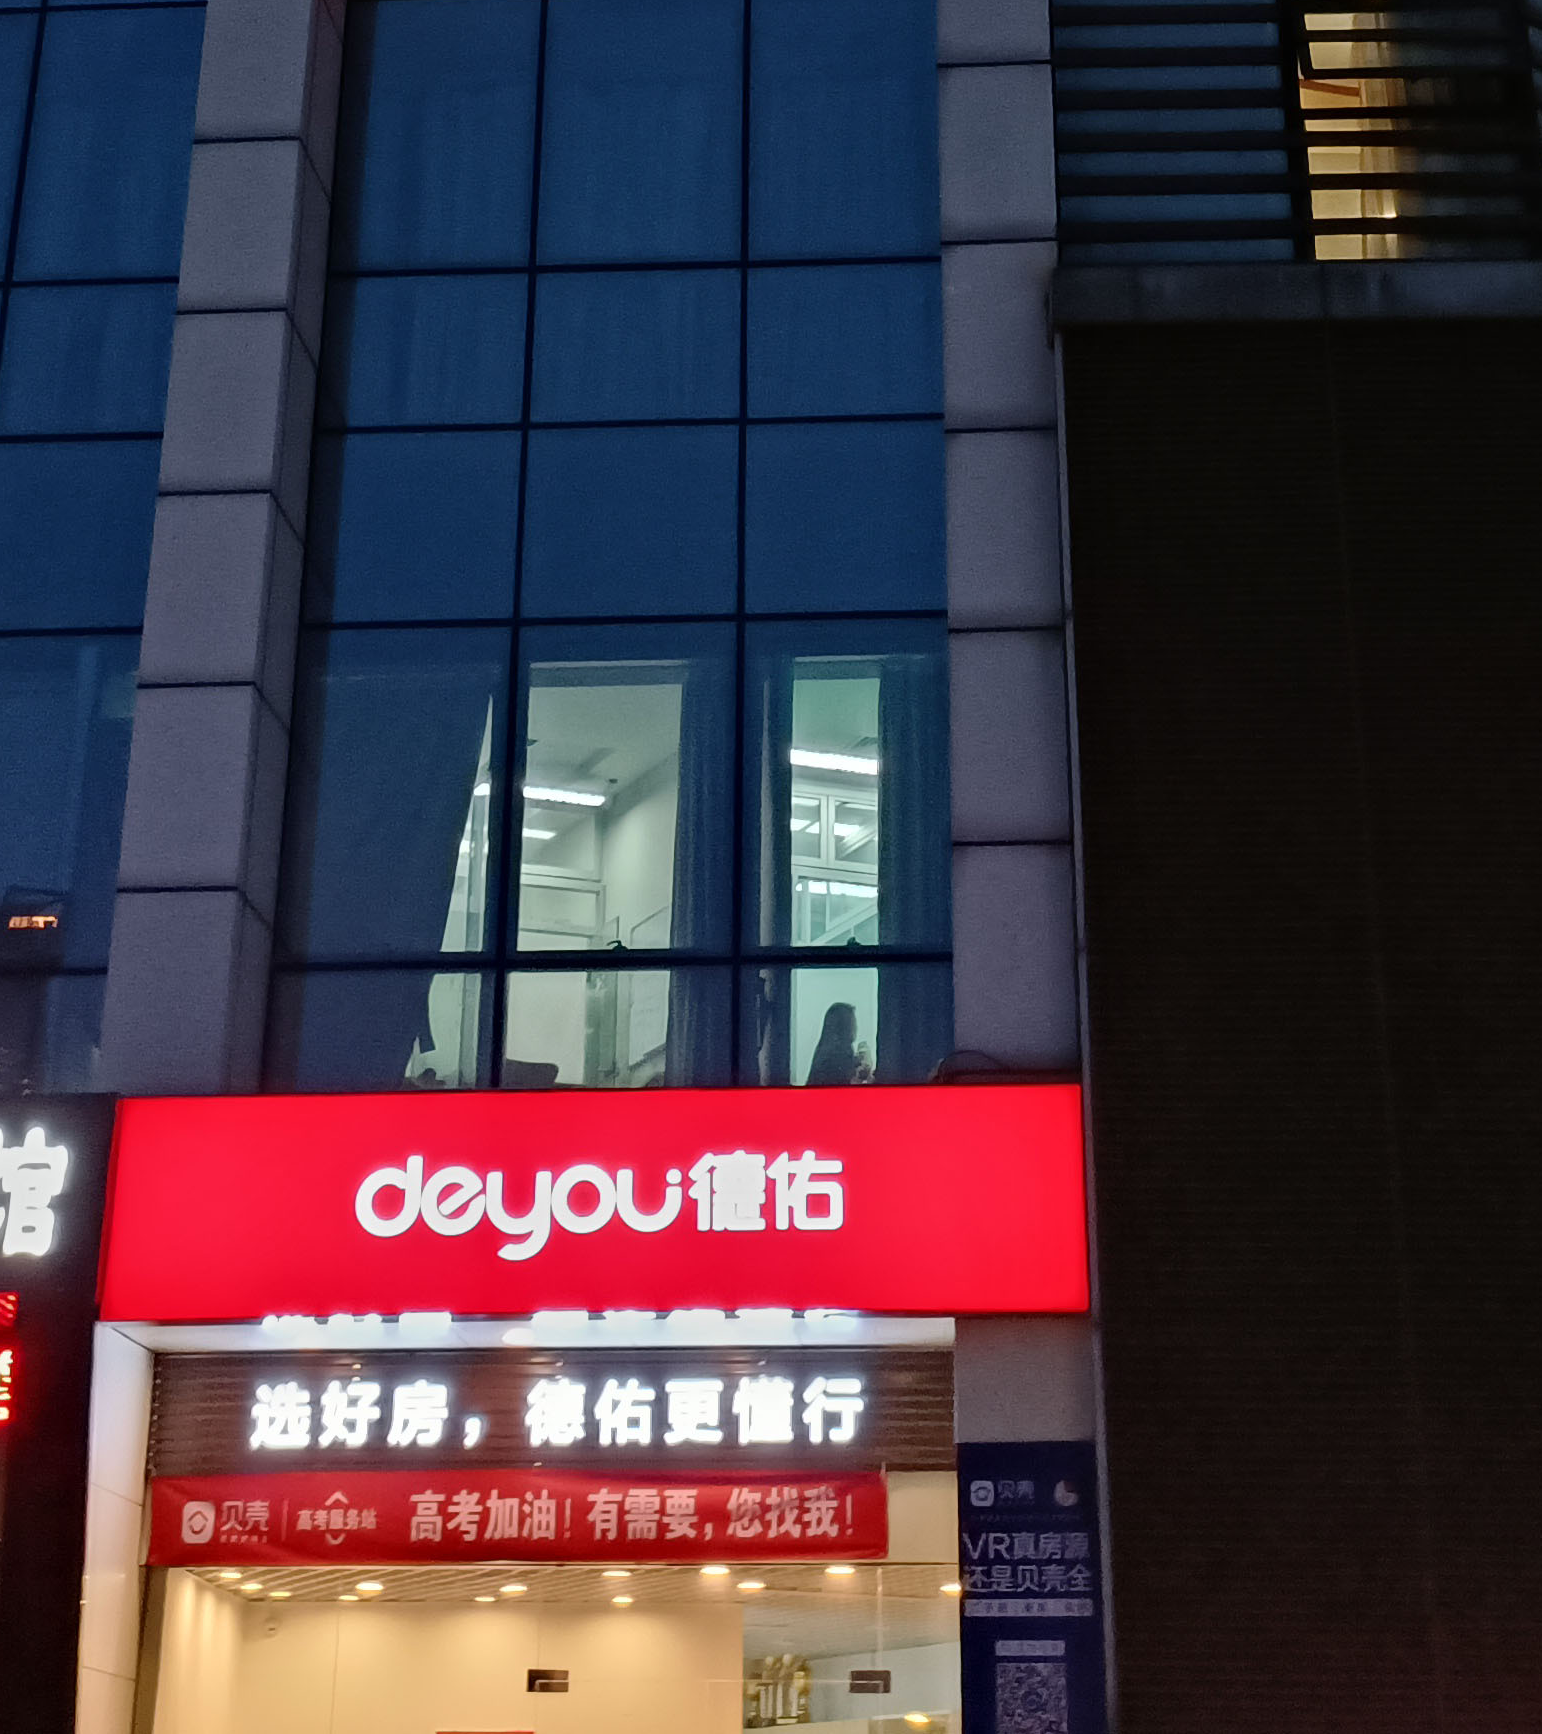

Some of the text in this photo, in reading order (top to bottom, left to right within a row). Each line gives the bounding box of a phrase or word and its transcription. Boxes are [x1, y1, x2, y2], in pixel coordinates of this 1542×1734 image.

[354, 1149, 845, 1262] deyou 德佑
[219, 1500, 271, 1532] 贝壳
[962, 1563, 1094, 1593] 还是贝壳全
